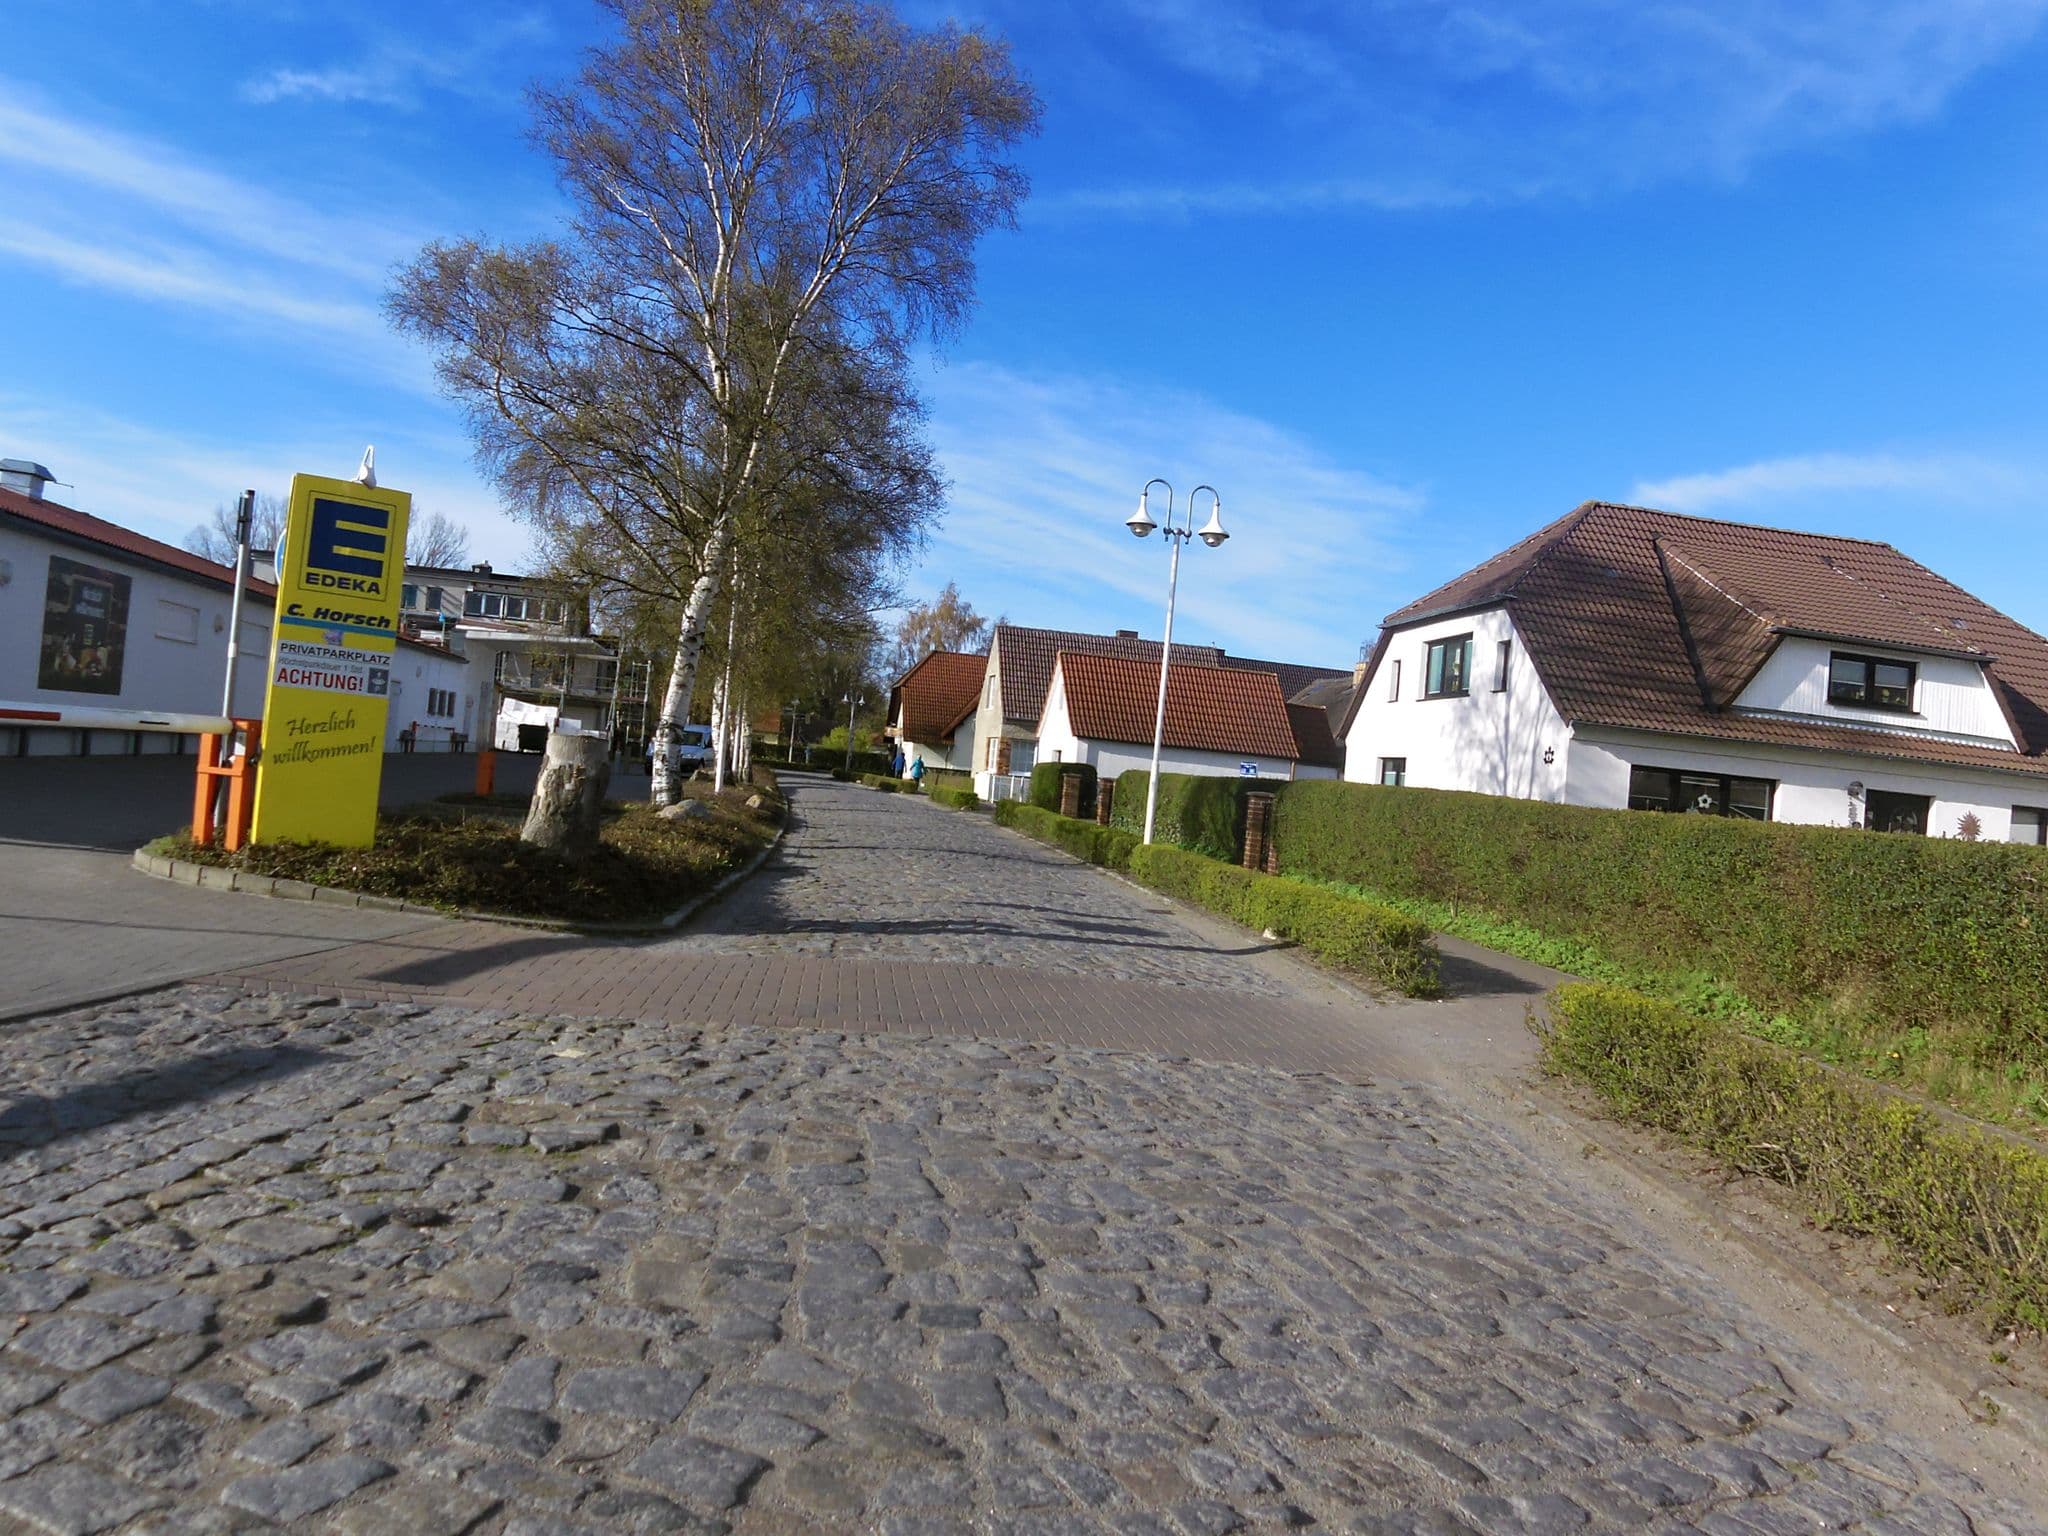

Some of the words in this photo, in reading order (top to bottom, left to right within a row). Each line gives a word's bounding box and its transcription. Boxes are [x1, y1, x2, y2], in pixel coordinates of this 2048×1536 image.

[308, 497, 390, 578] E
[305, 572, 381, 595] EDEKA
[287, 603, 305, 617] C.
[313, 607, 391, 629] Horsch
[280, 642, 391, 666] PRIVATPARKPLATZ
[277, 667, 363, 692] ACHTUNG!
[287, 709, 355, 737] Herzlich
[273, 736, 377, 764] willkommen!
